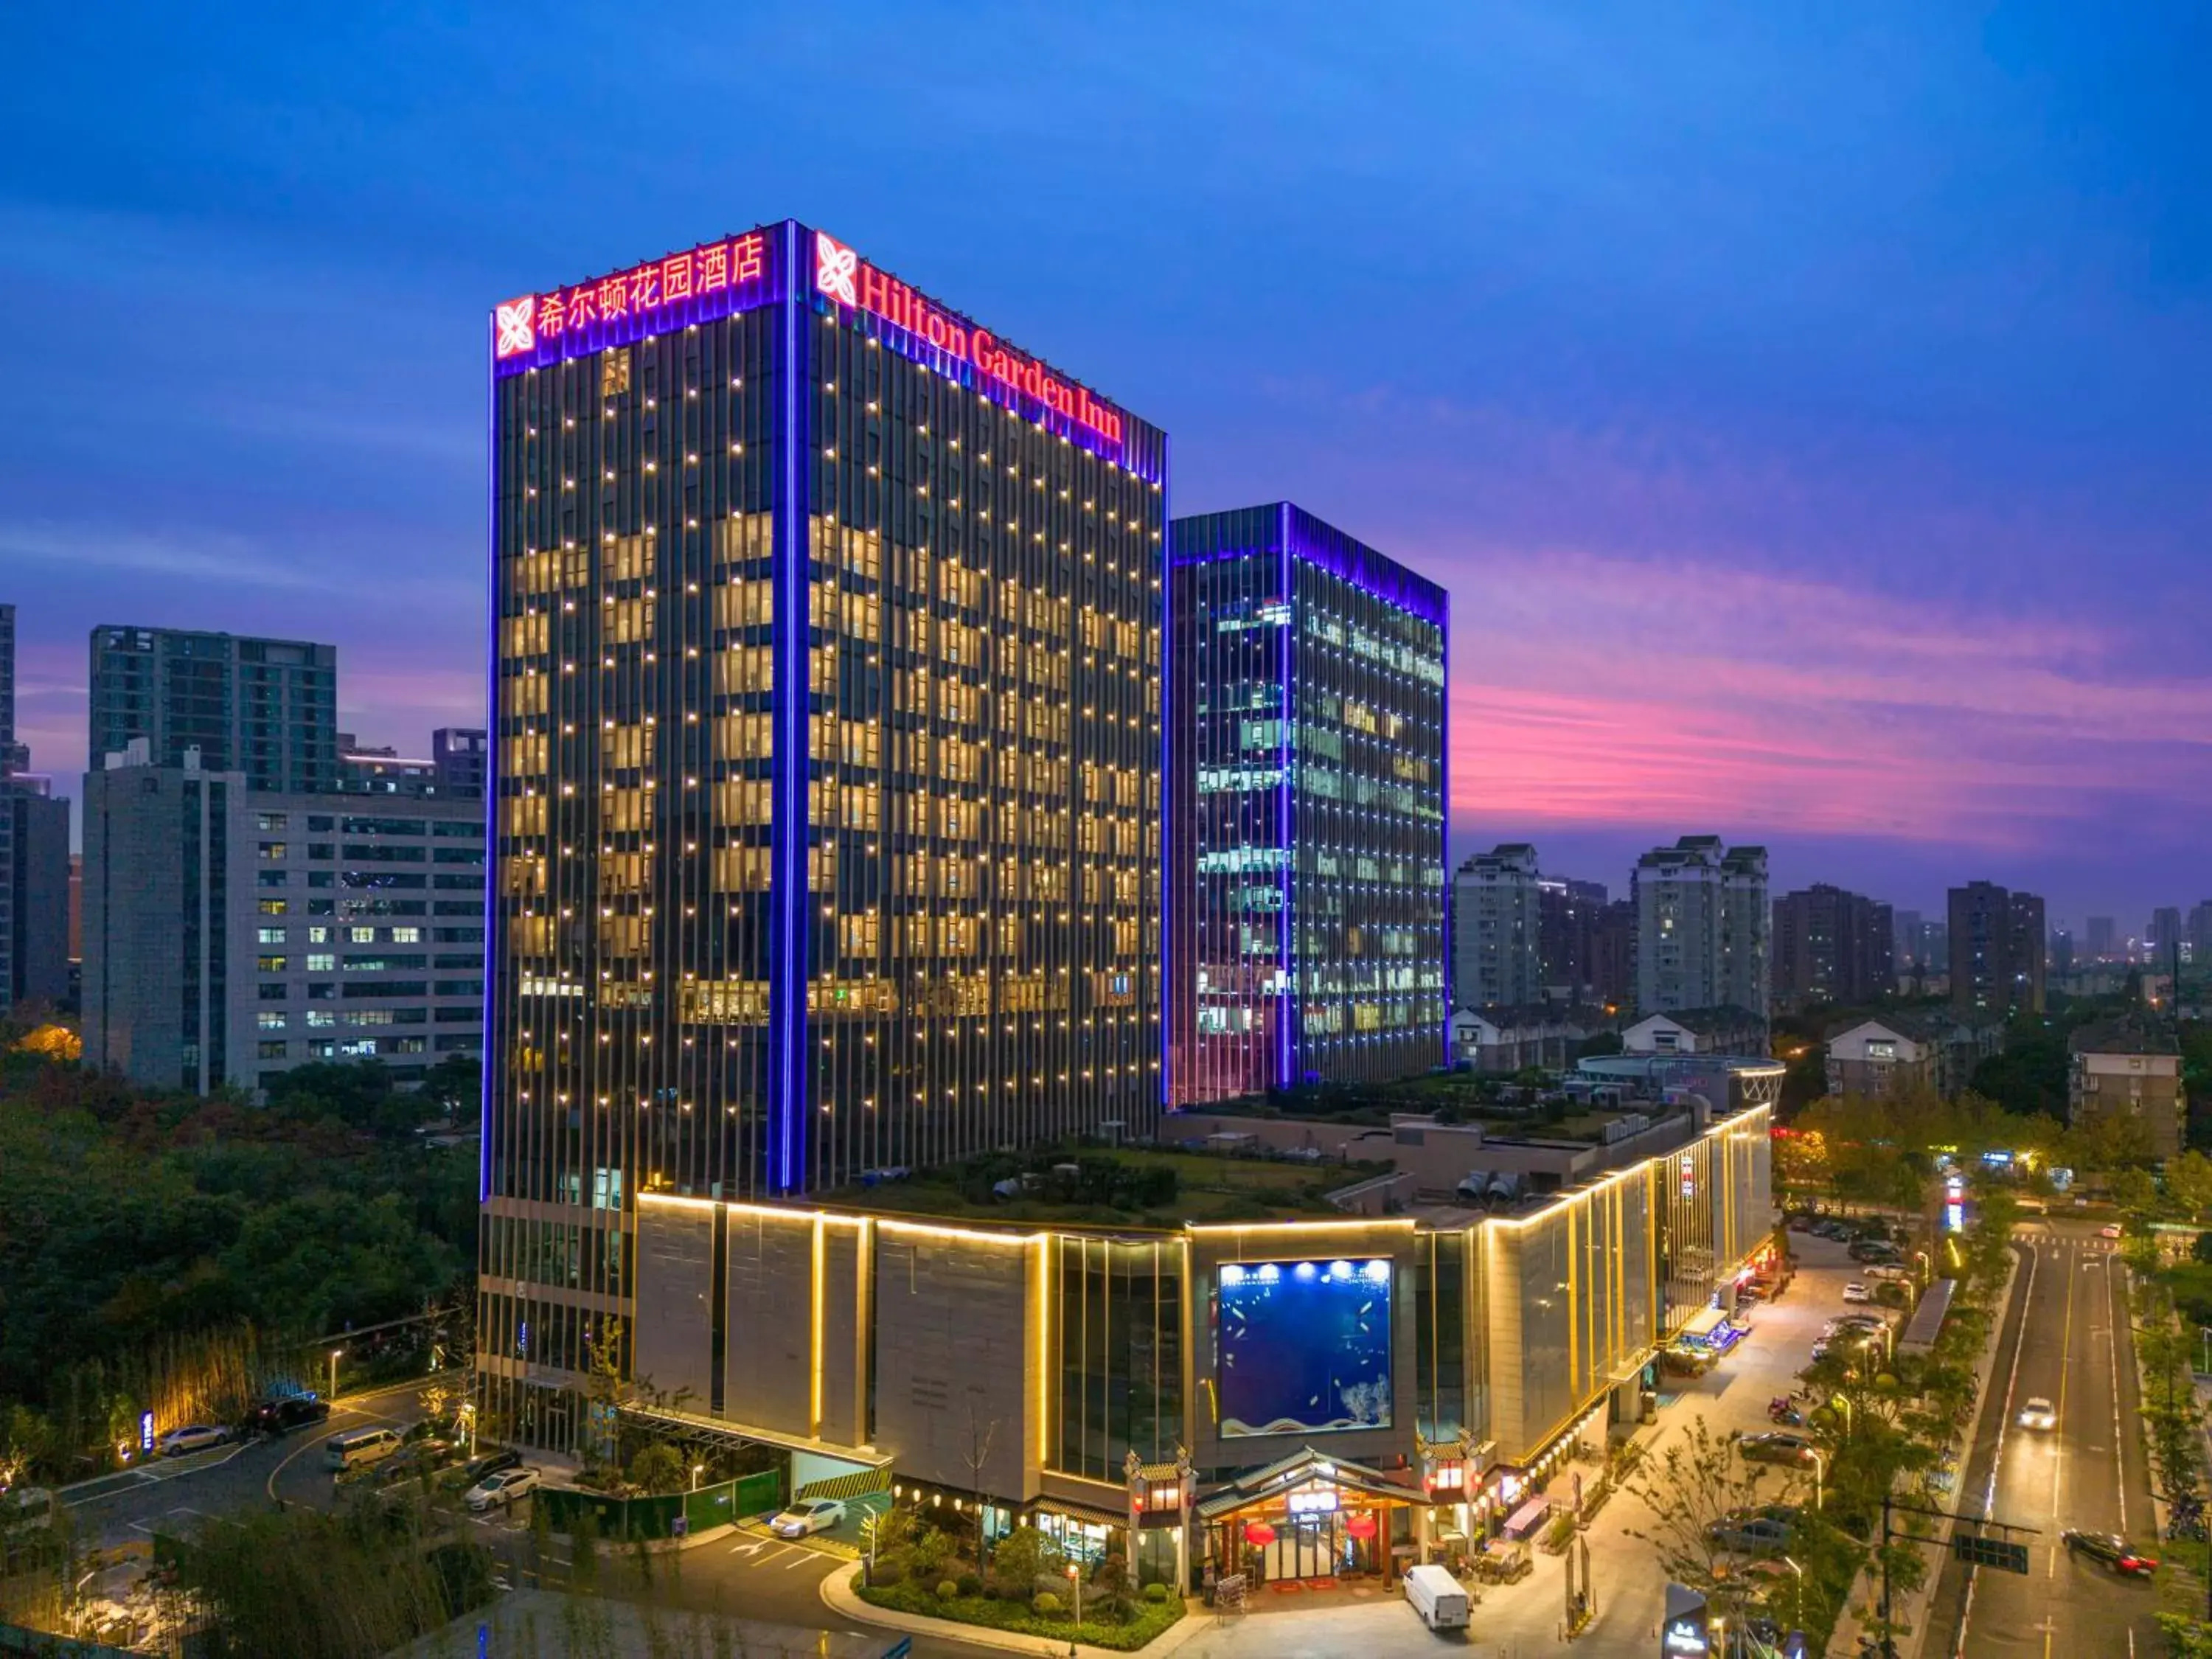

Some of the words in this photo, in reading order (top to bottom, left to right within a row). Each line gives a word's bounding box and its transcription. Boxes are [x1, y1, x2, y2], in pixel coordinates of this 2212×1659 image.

[538, 233, 764, 337] 希尔顿花园酒店
[863, 264, 967, 361] Hilton
[973, 330, 1074, 419] Garden
[1078, 387, 1121, 443] Inn
